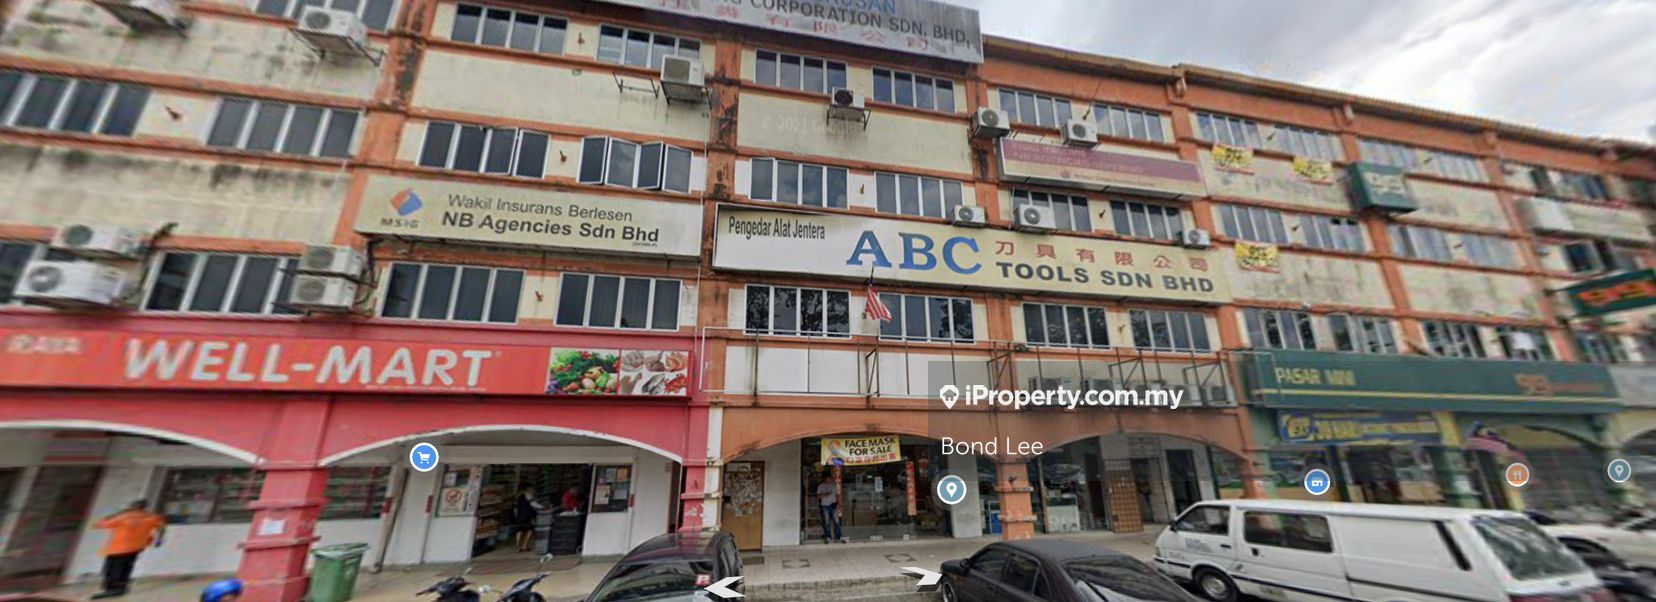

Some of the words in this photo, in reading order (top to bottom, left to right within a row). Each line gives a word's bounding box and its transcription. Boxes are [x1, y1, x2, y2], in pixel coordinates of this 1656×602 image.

[751, 0, 882, 28] CORPORATION
[448, 193, 492, 210] Wakil
[496, 198, 562, 216] Insurans
[568, 204, 633, 222] Berlesen
[442, 211, 473, 228] NB
[478, 214, 572, 236] Agencies
[580, 221, 615, 239] Sdn
[622, 226, 659, 242] Bhd
[728, 216, 771, 239] Pengedar
[773, 218, 791, 238] Alat
[793, 222, 825, 240] Jentera
[846, 230, 982, 275] ABC
[995, 240, 1208, 272] 刀具有限公司
[996, 261, 1089, 284] TOOLS
[1101, 270, 1152, 288] SDN
[1162, 275, 1214, 293] BHD
[124, 337, 492, 387] WELL-MART
[845, 439, 867, 448] FACE
[868, 437, 896, 446] MASK
[849, 447, 869, 456] FOR
[870, 445, 892, 455] SALE
